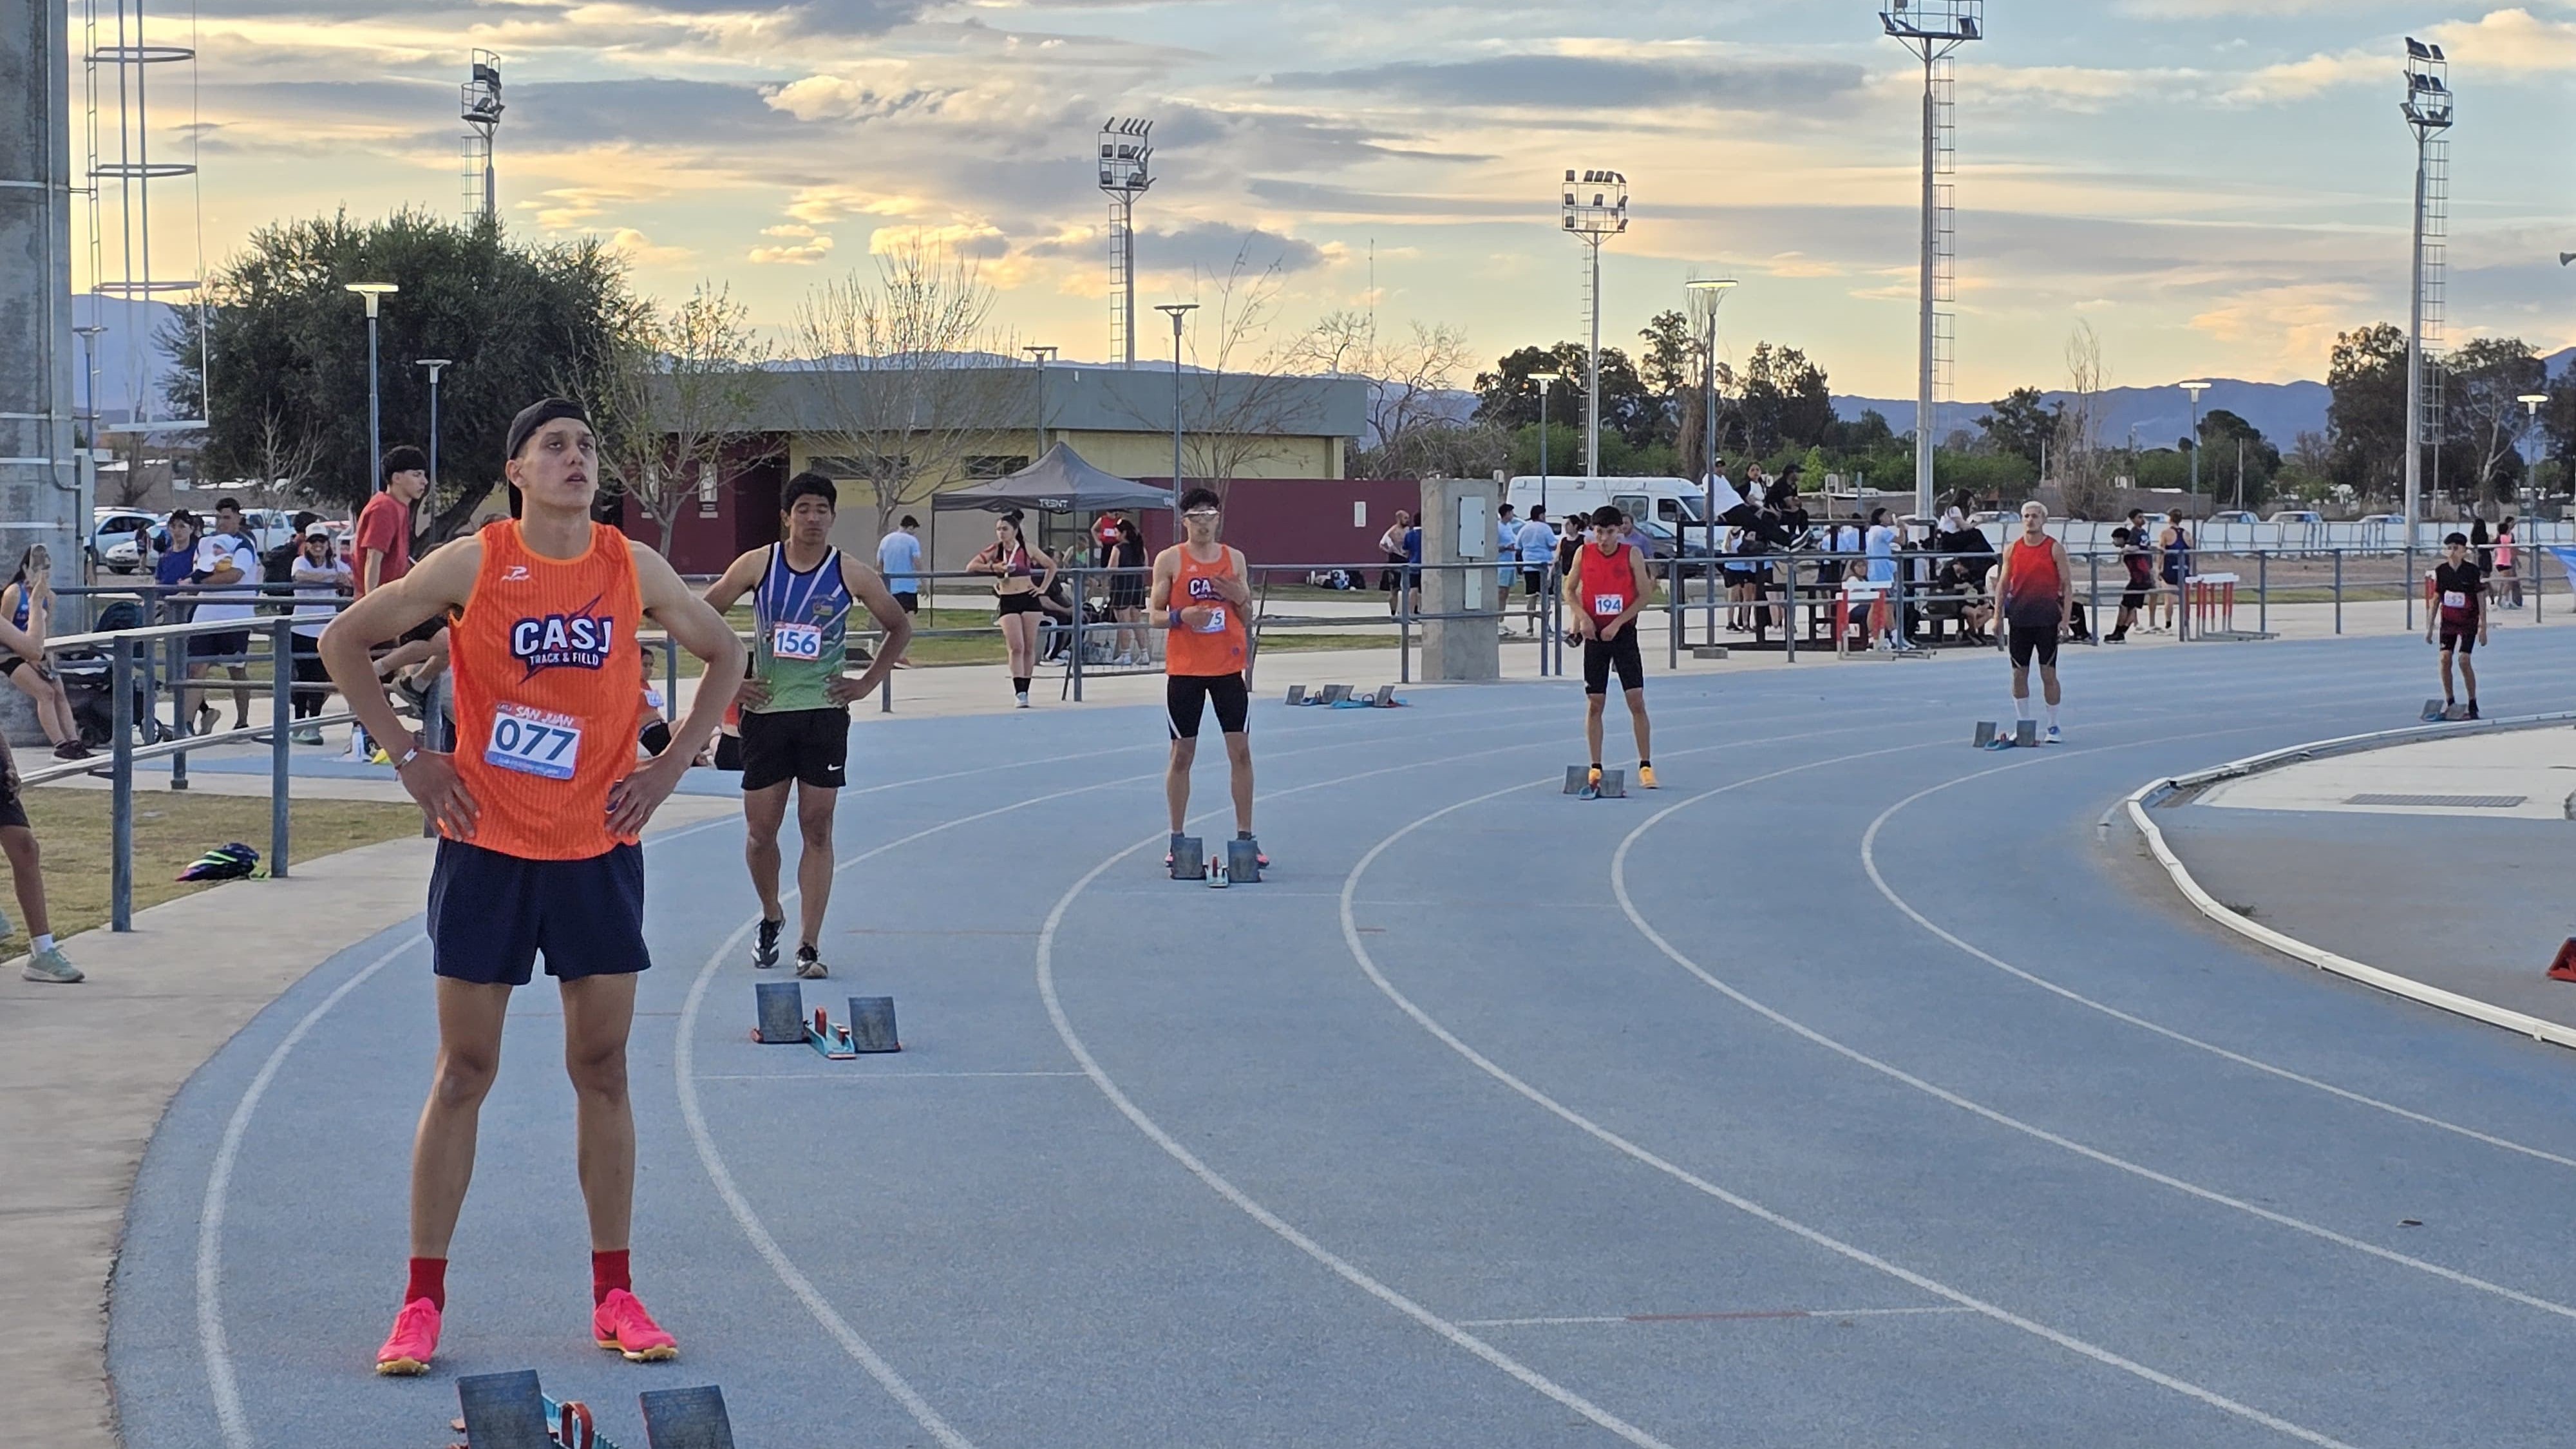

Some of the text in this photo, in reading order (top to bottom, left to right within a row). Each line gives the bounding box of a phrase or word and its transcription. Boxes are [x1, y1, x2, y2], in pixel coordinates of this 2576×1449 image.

[1189, 579, 1211, 595] CA
[1597, 599, 1621, 612] 194
[515, 618, 612, 656] CASJ
[777, 630, 817, 655] 156
[529, 652, 600, 666] TRACK & FIELD
[515, 705, 542, 721] SAN
[542, 712, 574, 727] JUAN
[495, 719, 576, 761] 077
